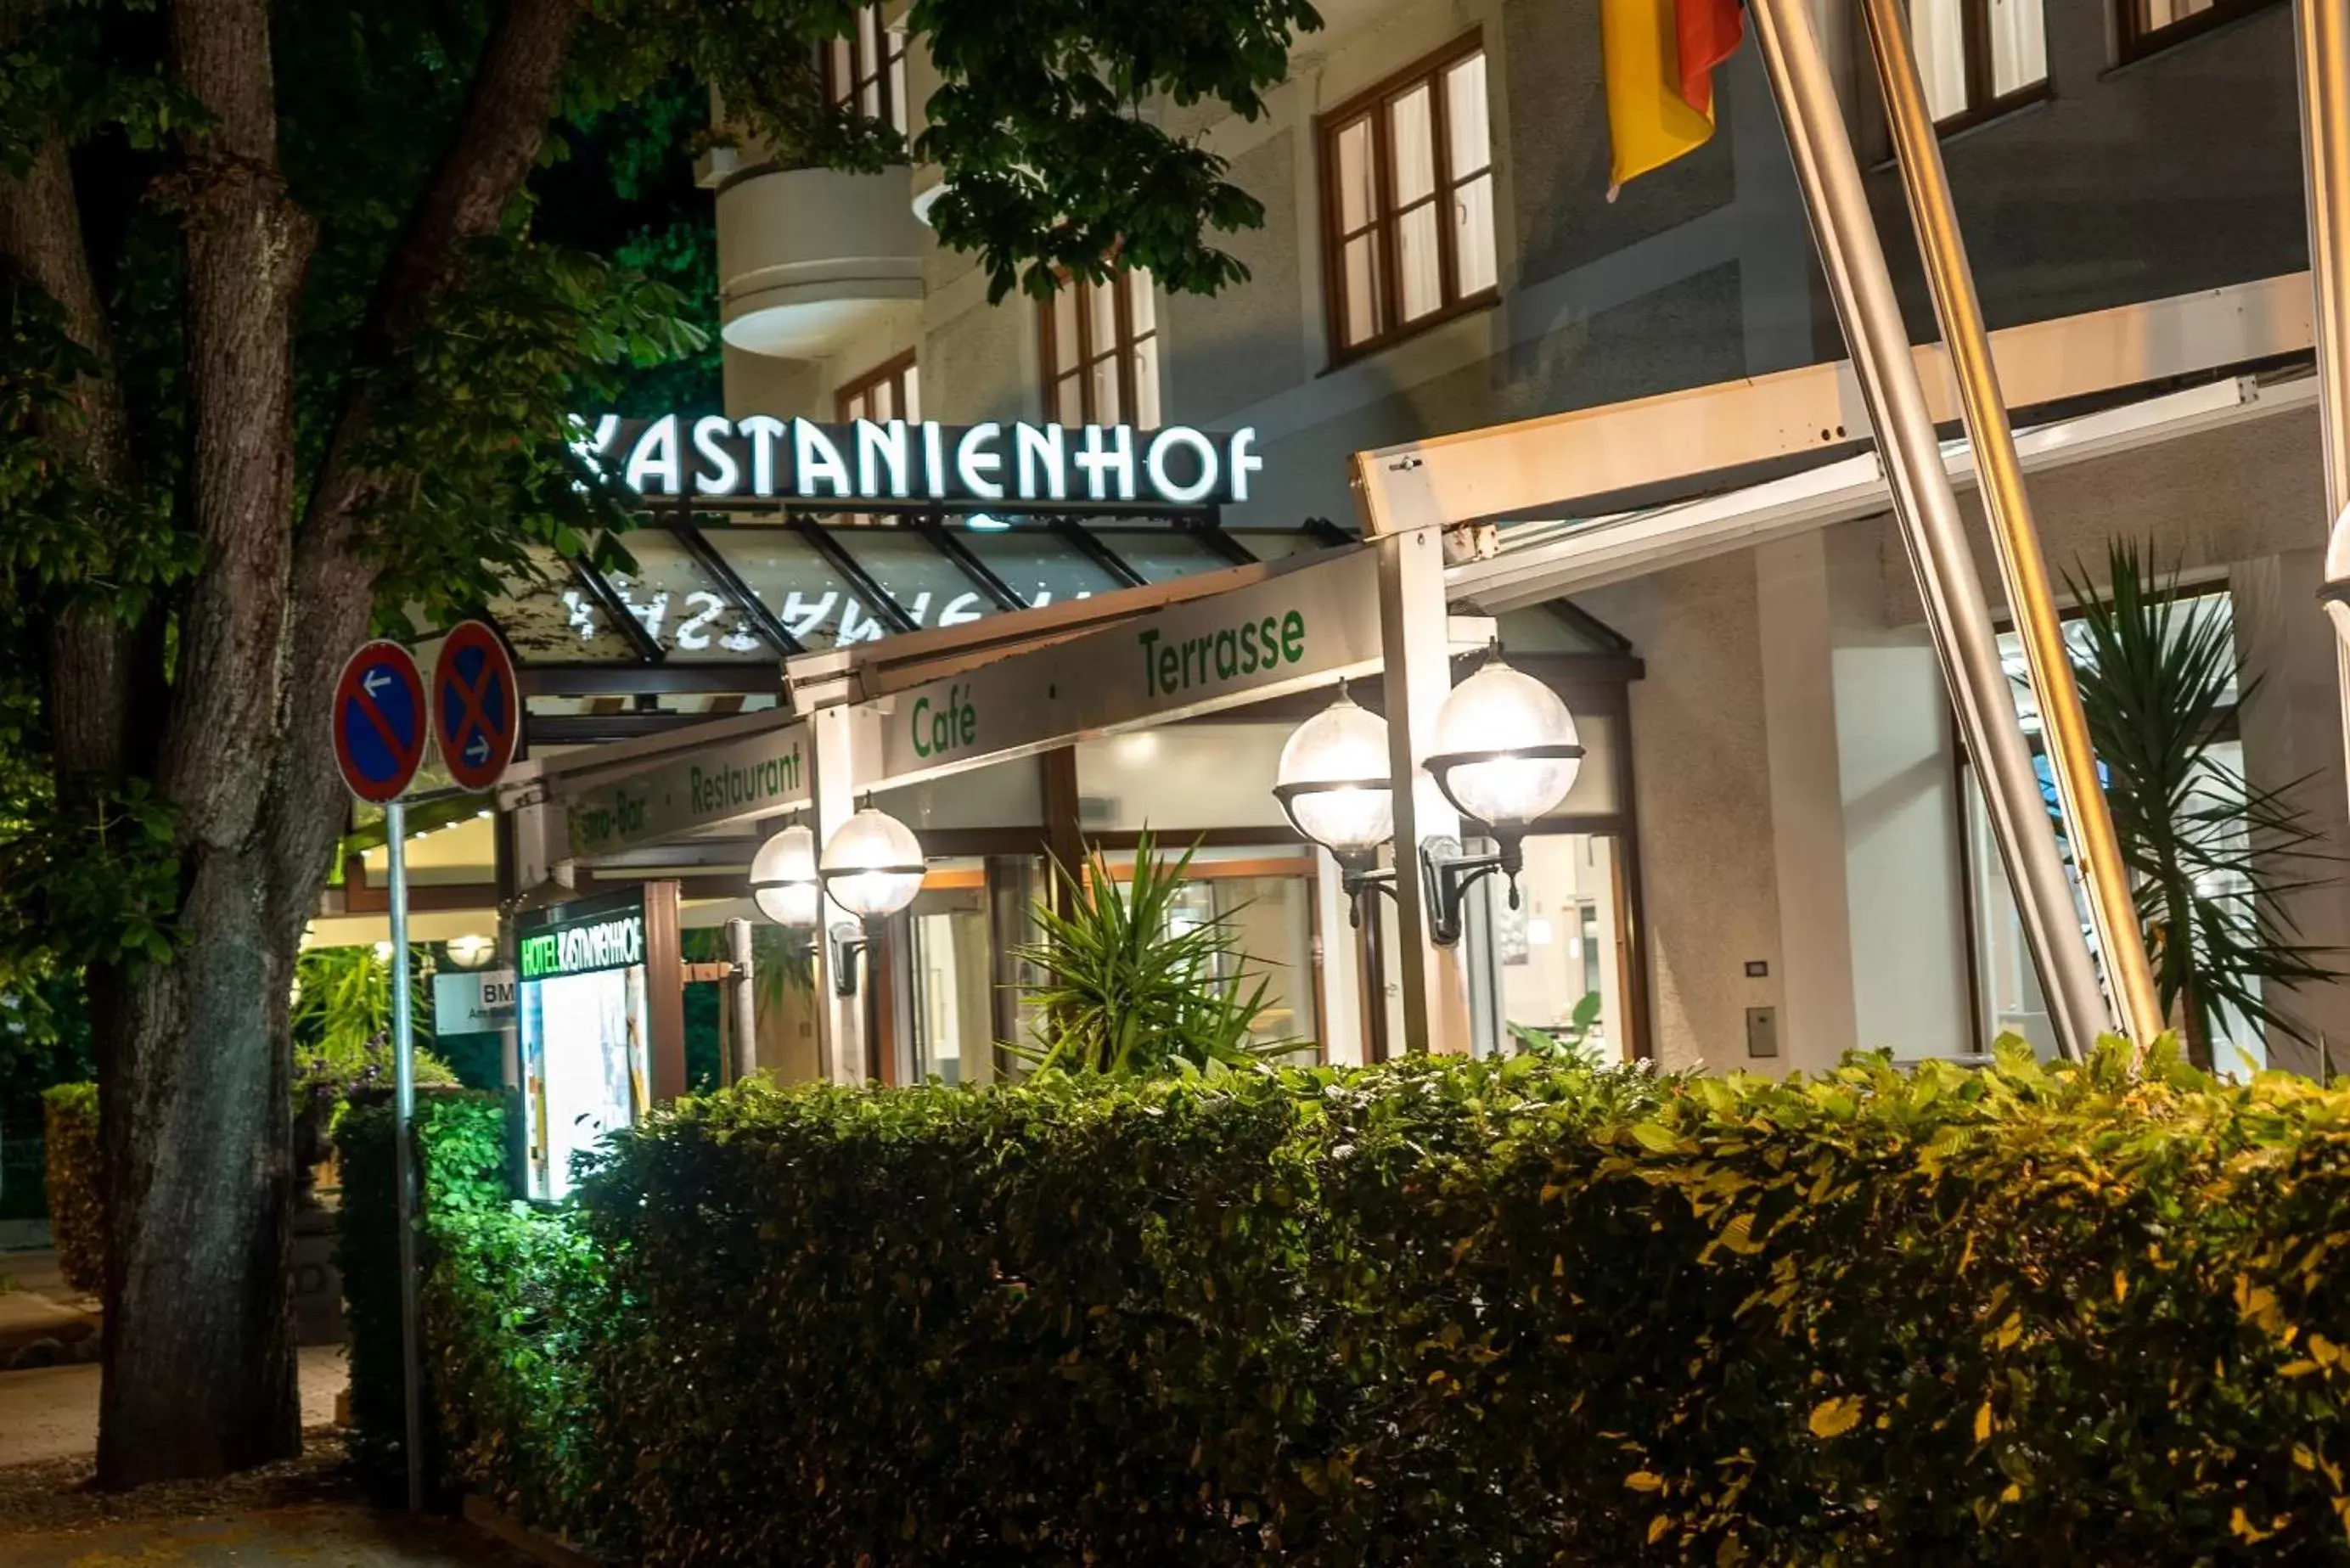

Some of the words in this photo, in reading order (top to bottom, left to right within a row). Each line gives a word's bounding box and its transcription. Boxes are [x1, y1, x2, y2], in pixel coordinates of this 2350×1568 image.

[912, 684, 975, 758] Café
[1138, 610, 1306, 698] Terrasse
[690, 741, 801, 814] Restaurant
[521, 935, 558, 976] HOTEL
